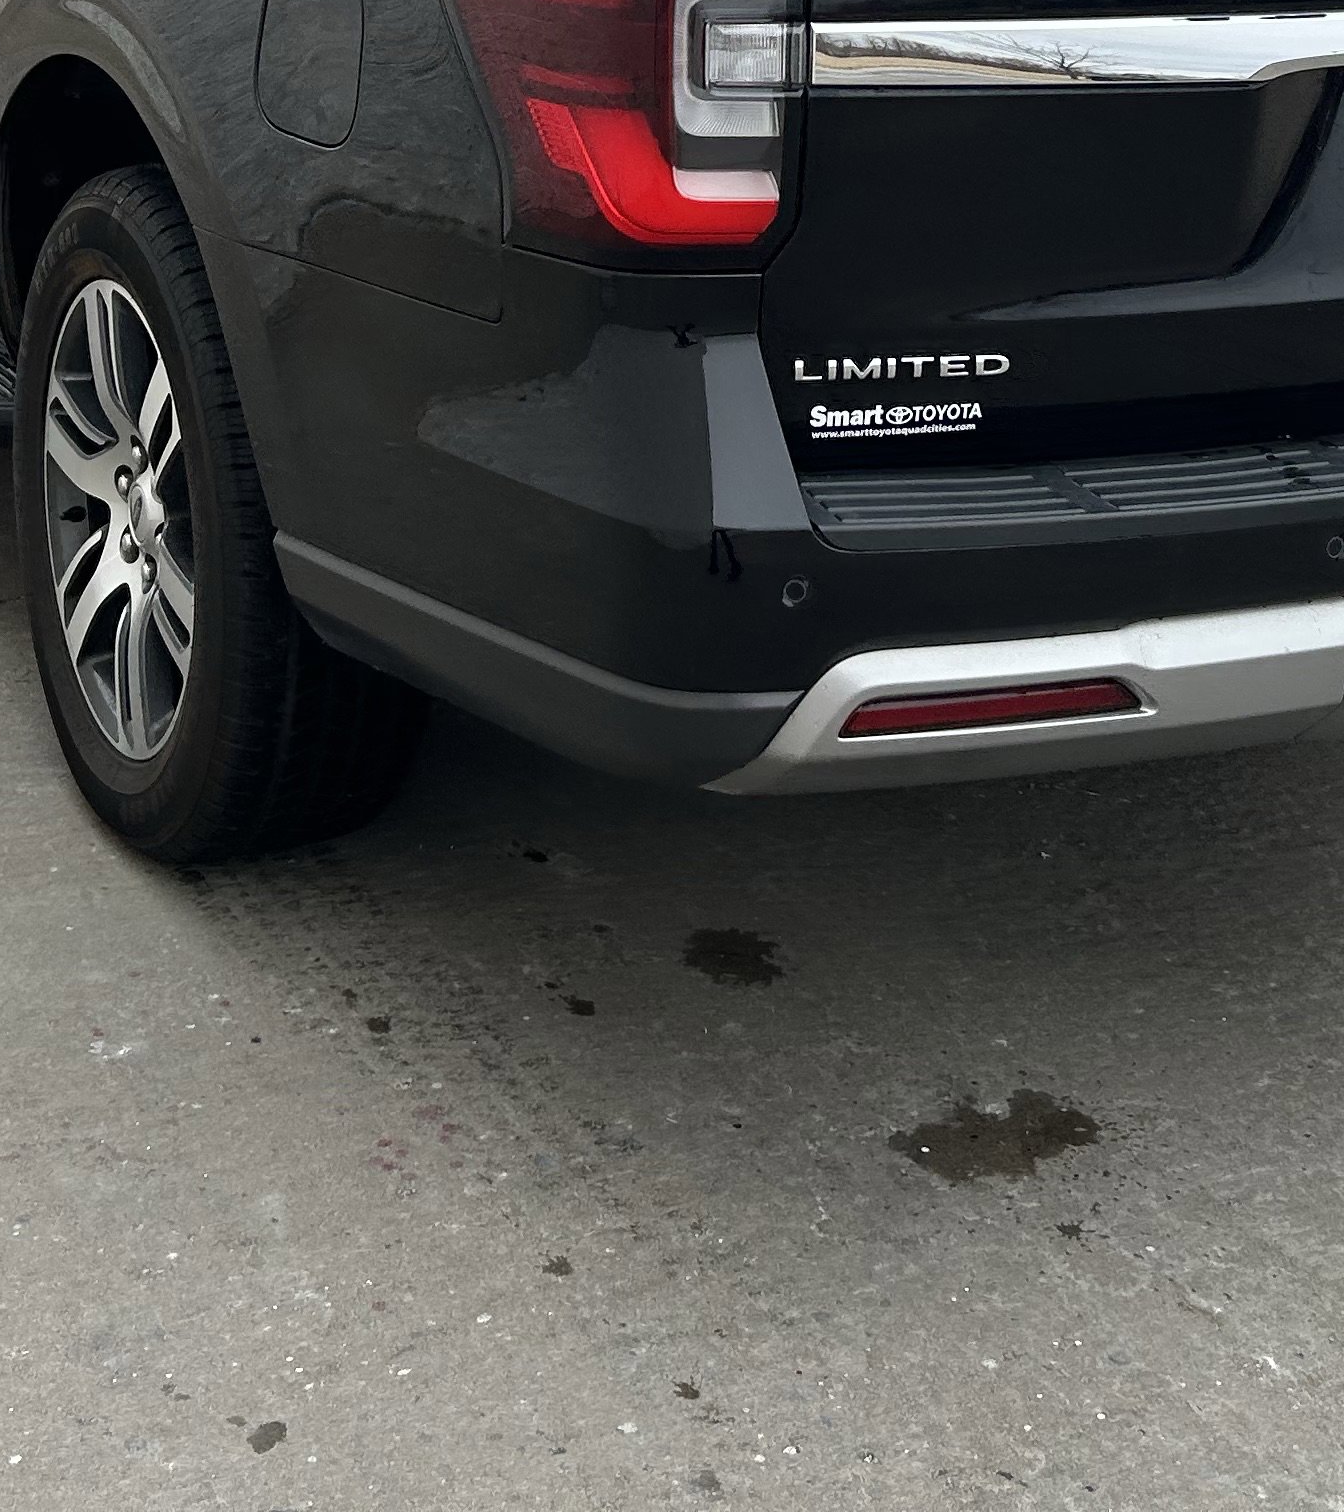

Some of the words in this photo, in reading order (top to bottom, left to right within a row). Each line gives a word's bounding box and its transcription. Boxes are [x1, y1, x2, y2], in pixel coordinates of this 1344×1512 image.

[794, 354, 1011, 382] LIMITED
[810, 404, 884, 428] Smart
[912, 402, 983, 422] TOYOTA
[811, 423, 976, 439] www.smarttoyotaquadcities.com
